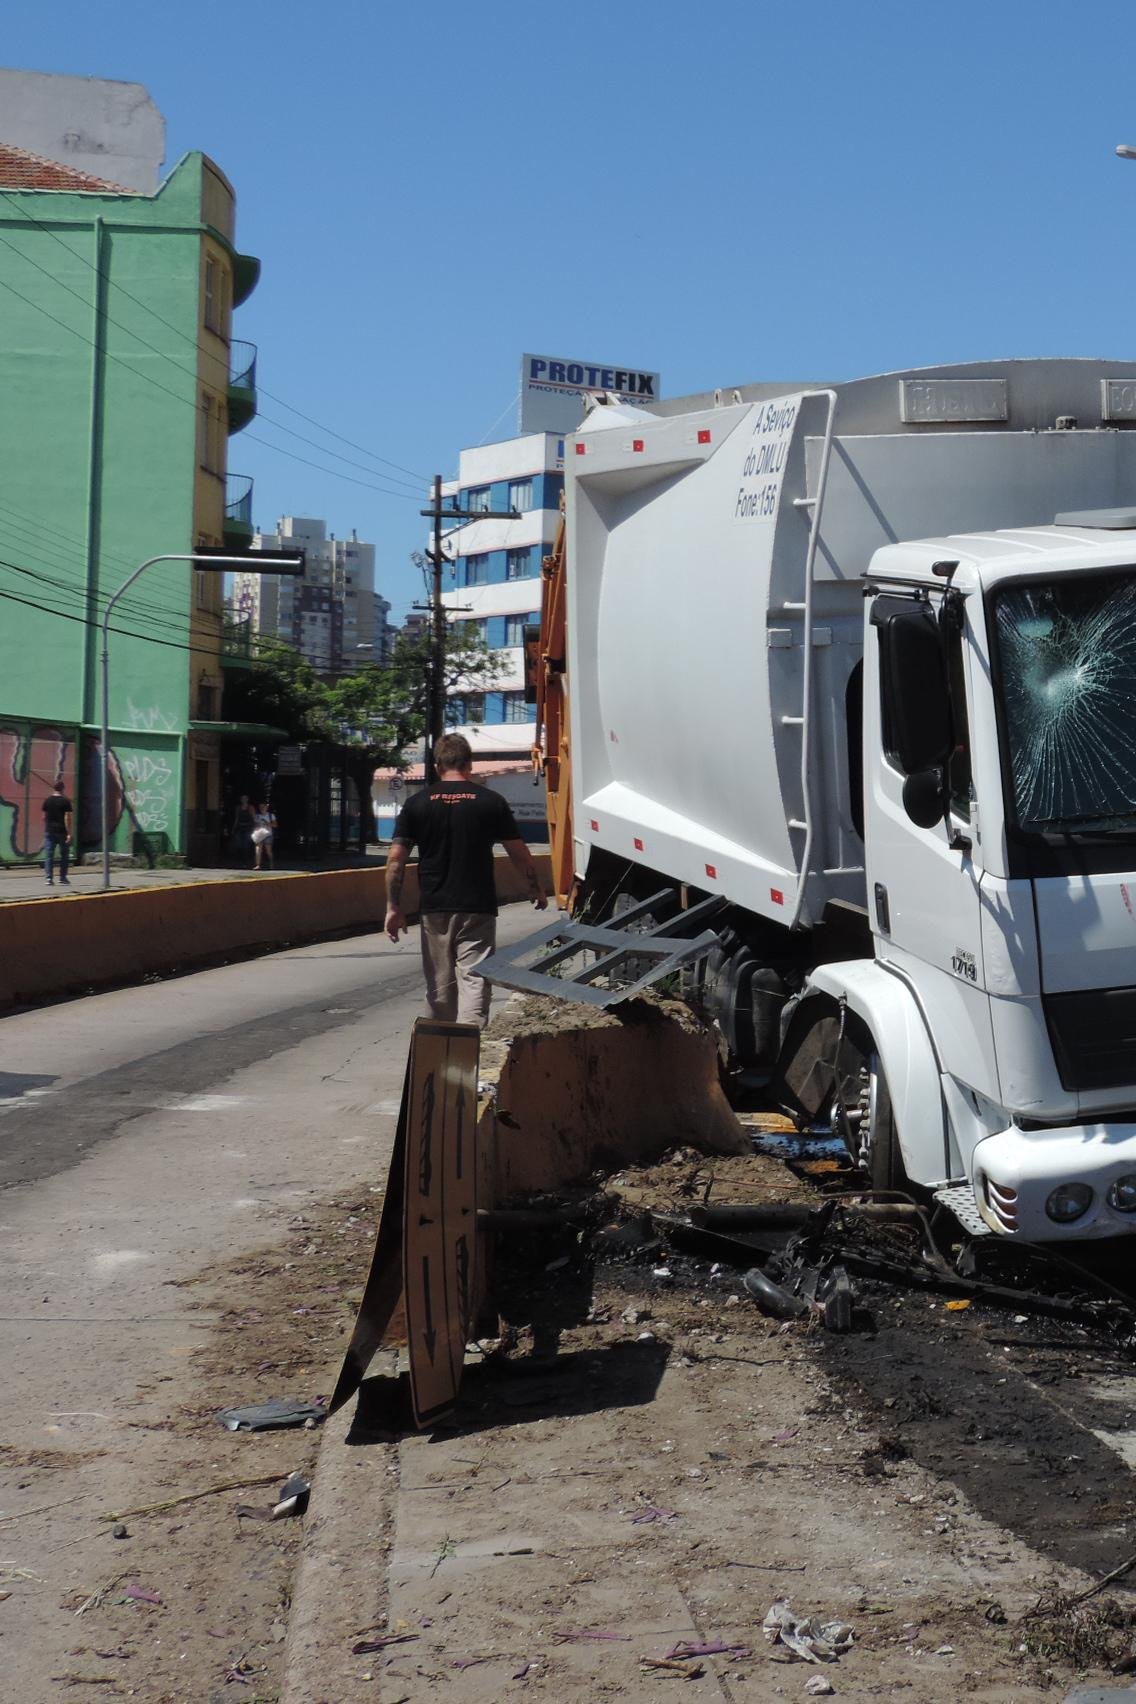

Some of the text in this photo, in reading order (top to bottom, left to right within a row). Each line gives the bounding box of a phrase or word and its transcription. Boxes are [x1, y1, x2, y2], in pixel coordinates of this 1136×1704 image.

[530, 358, 654, 395] PROTEFIX
[752, 405, 765, 435] A
[743, 442, 787, 477] do DMLU
[950, 956, 978, 982] 1719
